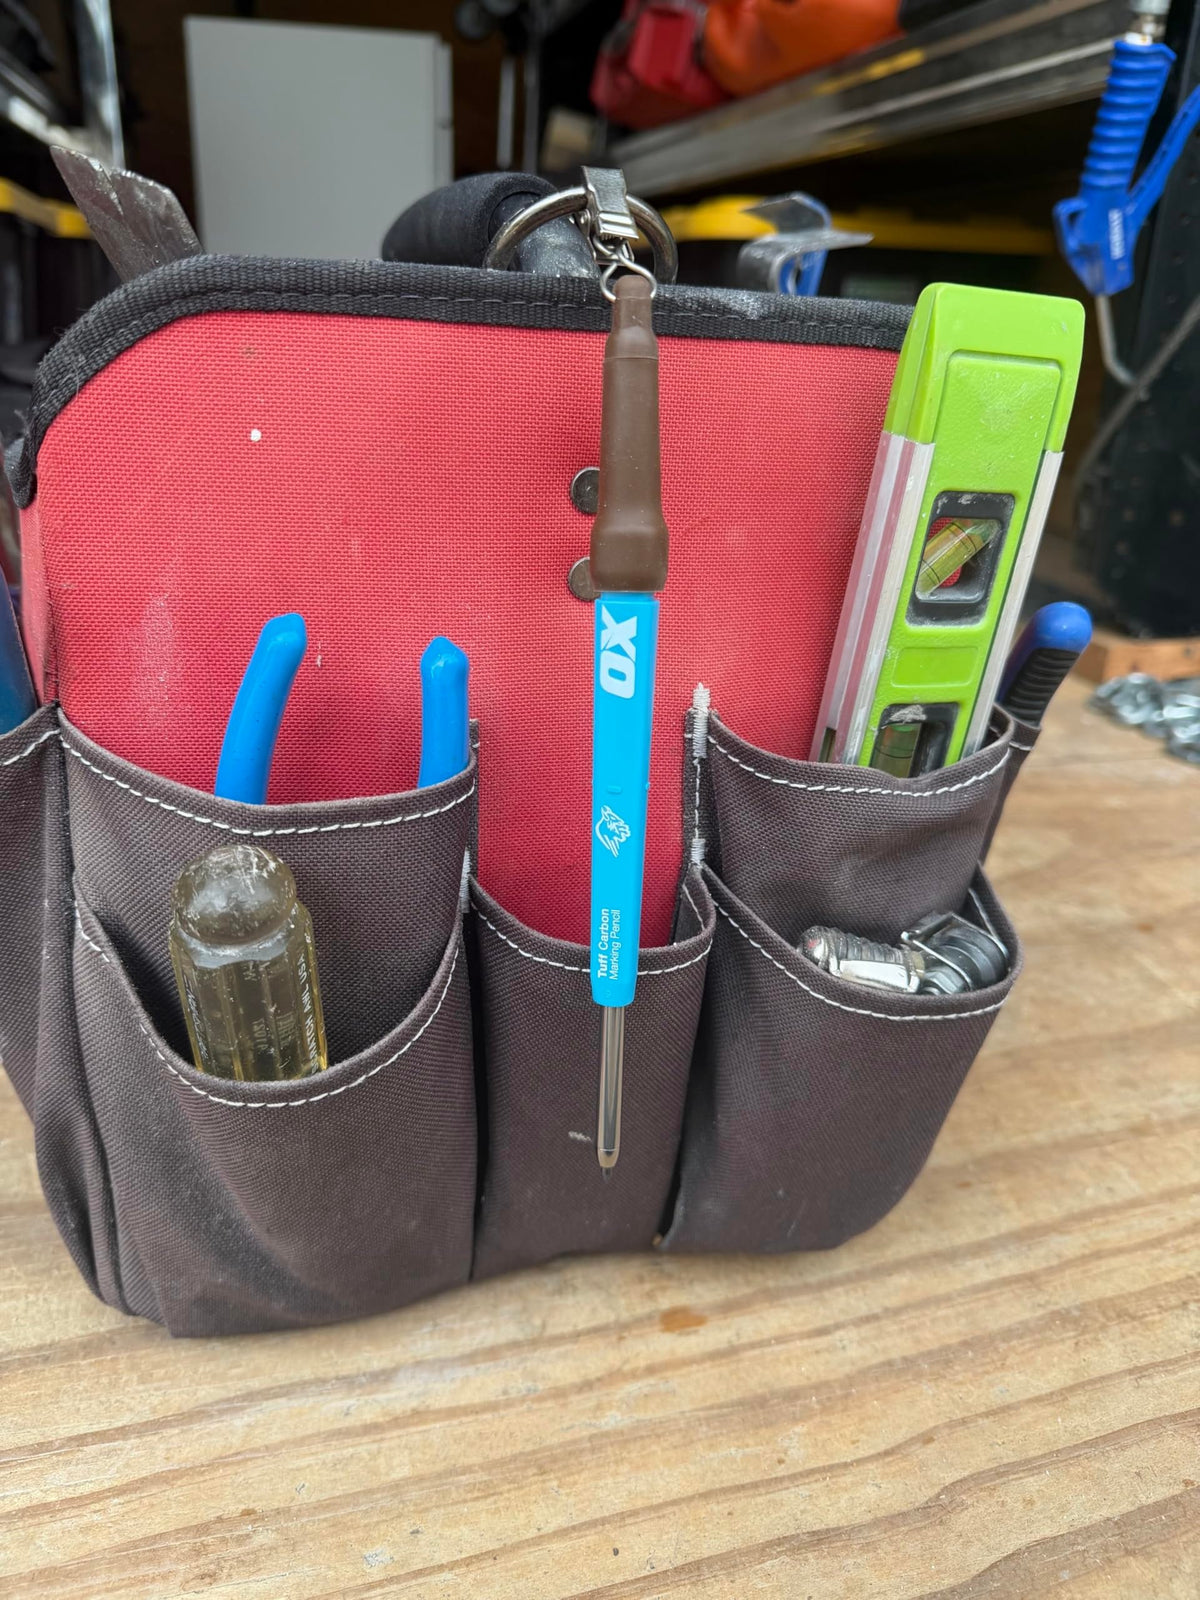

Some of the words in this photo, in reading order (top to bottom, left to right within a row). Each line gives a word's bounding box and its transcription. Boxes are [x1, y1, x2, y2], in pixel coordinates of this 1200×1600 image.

[600, 604, 638, 699] OX
[598, 908, 610, 951] Carbon
[610, 909, 621, 939] Pencil
[297, 953, 307, 984] USA
[597, 953, 608, 978] Tuff
[609, 941, 622, 980] Marking
[302, 984, 312, 1012] AWL
[305, 1014, 319, 1074] SCRATCH
